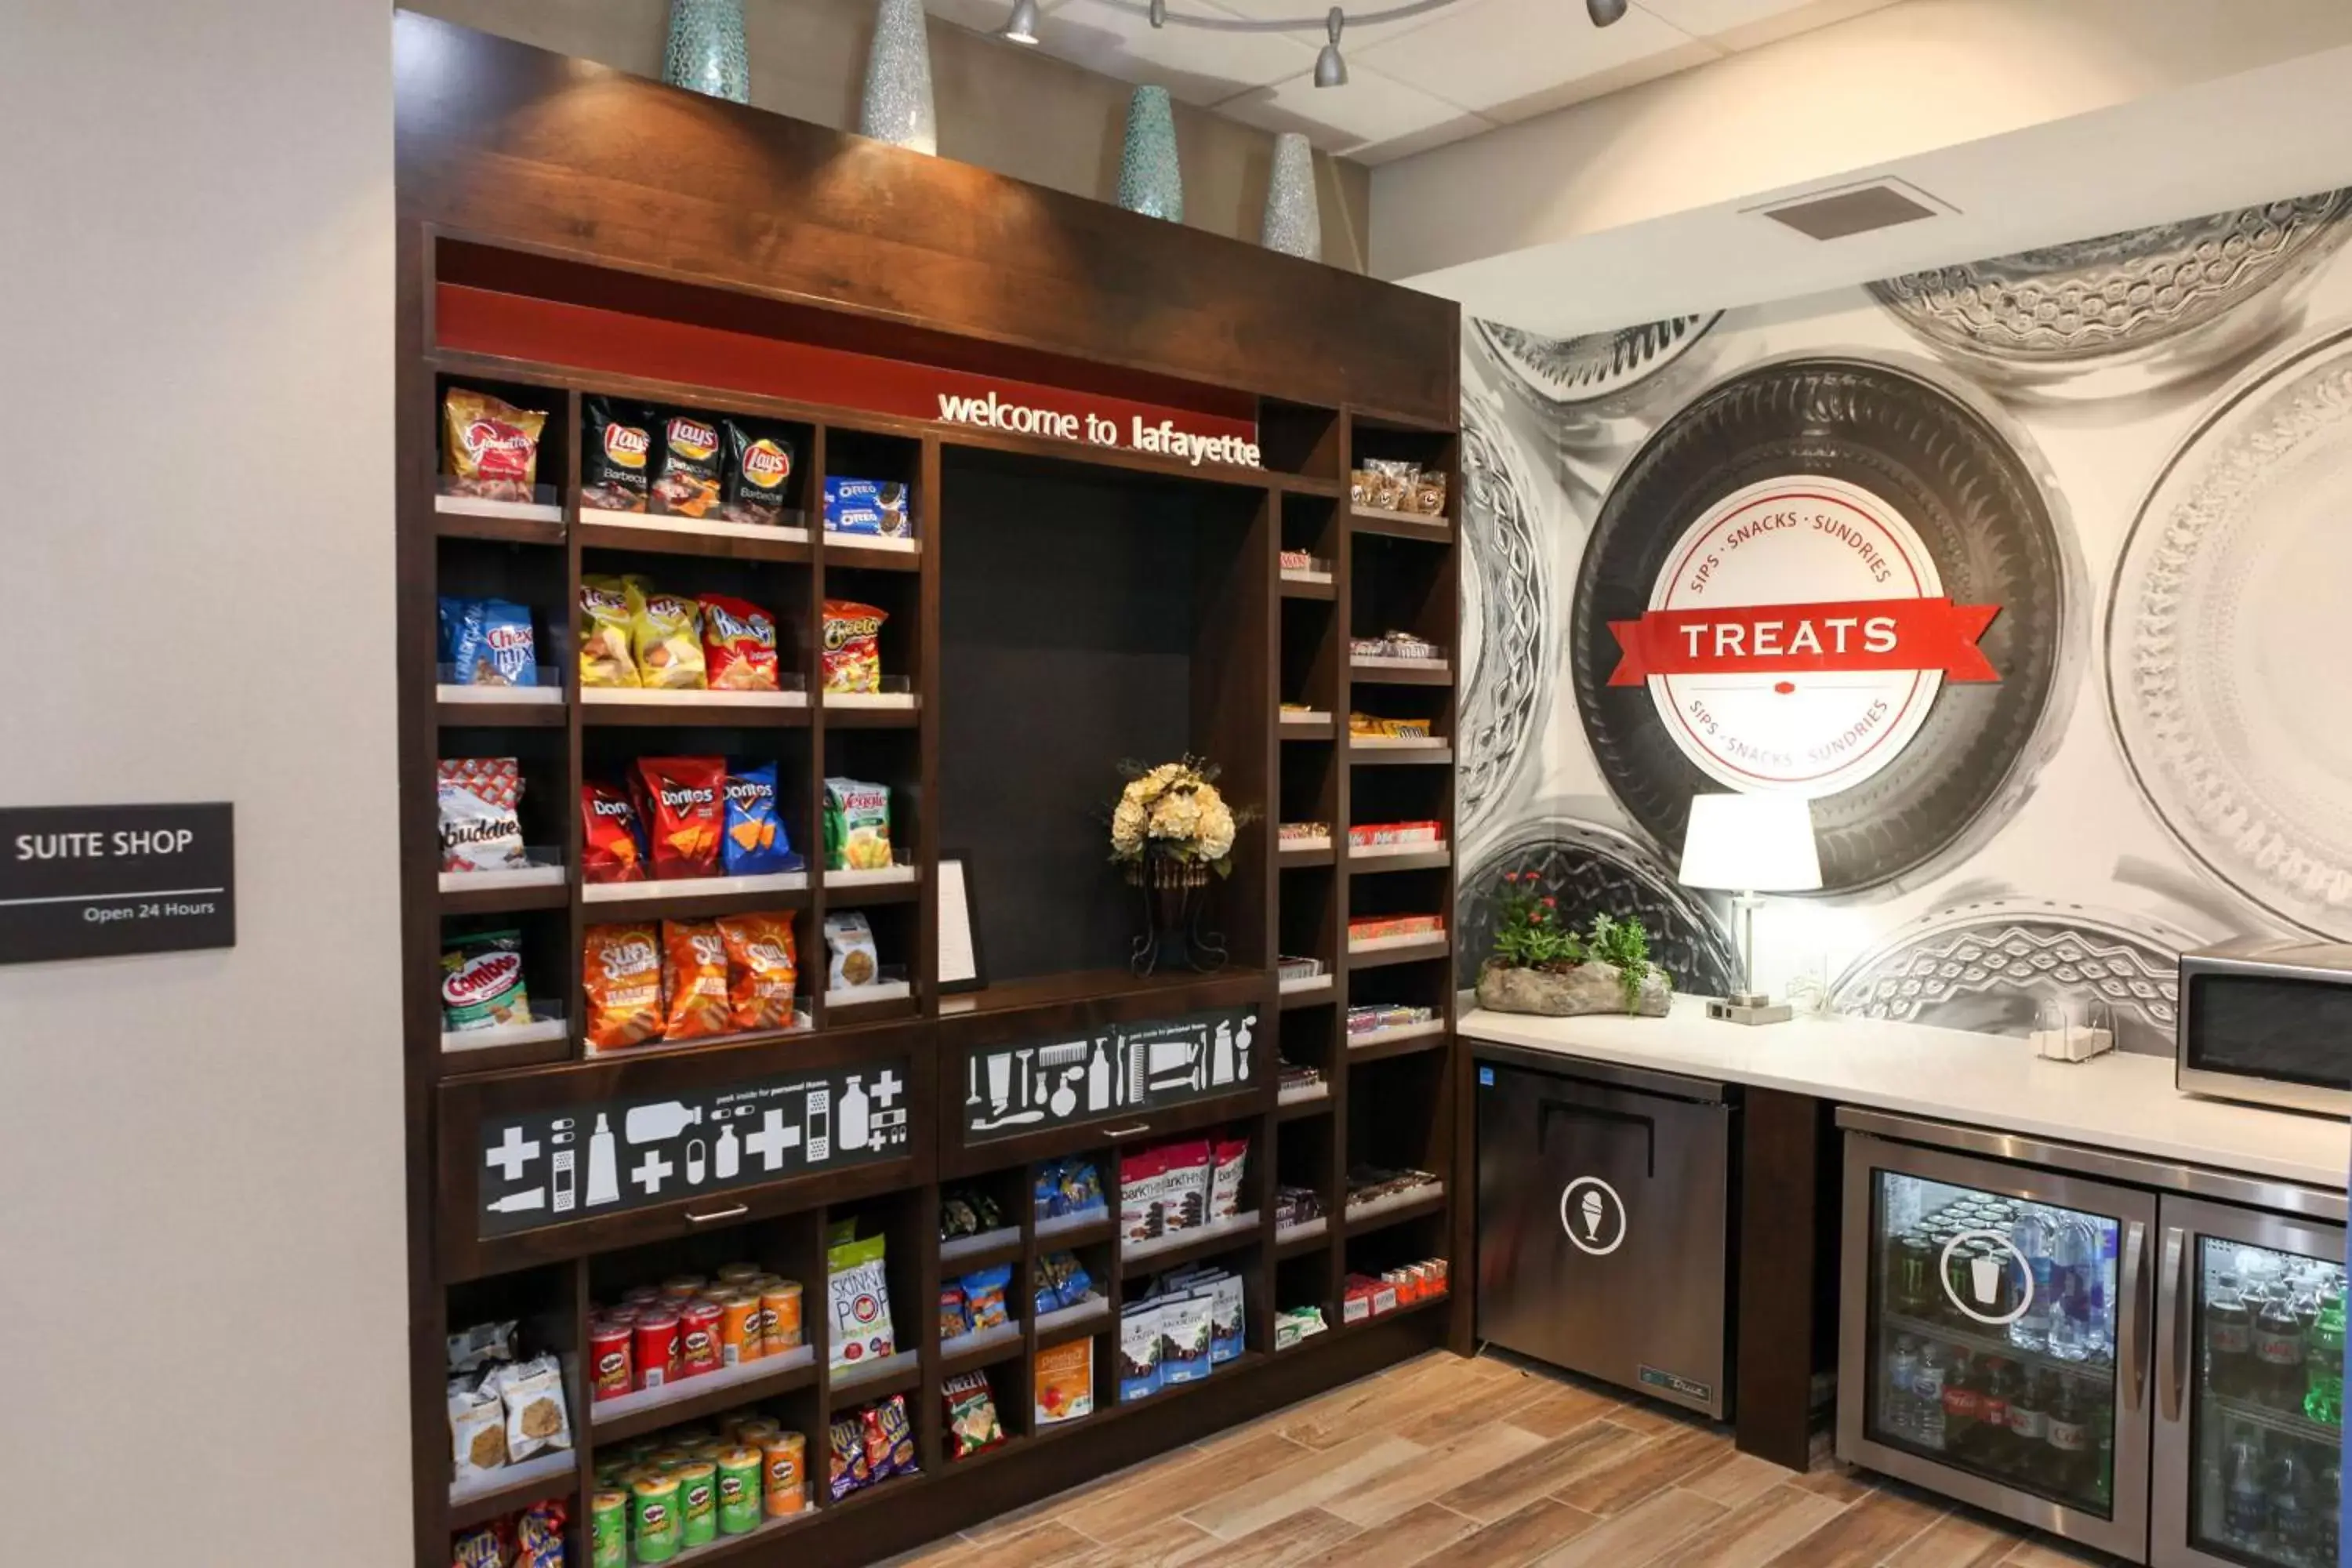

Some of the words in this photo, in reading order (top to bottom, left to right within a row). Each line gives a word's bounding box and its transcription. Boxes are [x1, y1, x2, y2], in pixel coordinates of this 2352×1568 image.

[938, 391, 1080, 440] welcome
[1085, 413, 1117, 445] to
[1132, 416, 1261, 466] lafayette
[603, 467, 647, 485] Barbecu
[1691, 554, 1719, 593] SIPS
[1727, 512, 1797, 550] SNACKS
[1813, 514, 1891, 583] SUNDRIES
[487, 625, 532, 649] Chex
[823, 617, 878, 651] Cheeto
[1680, 617, 1899, 658] TREATS
[1690, 700, 1719, 735] SIPS
[1727, 737, 1793, 768] SNACKS
[1807, 699, 1888, 764] SUNDRIES
[661, 789, 713, 806] Doritos
[16, 833, 104, 860] SUITE
[112, 829, 194, 856] SHOP
[83, 906, 134, 924] Open
[138, 904, 159, 919] 24
[165, 902, 216, 916] Hours
[832, 1265, 885, 1301] SKINNY
[837, 1286, 888, 1330] POP
